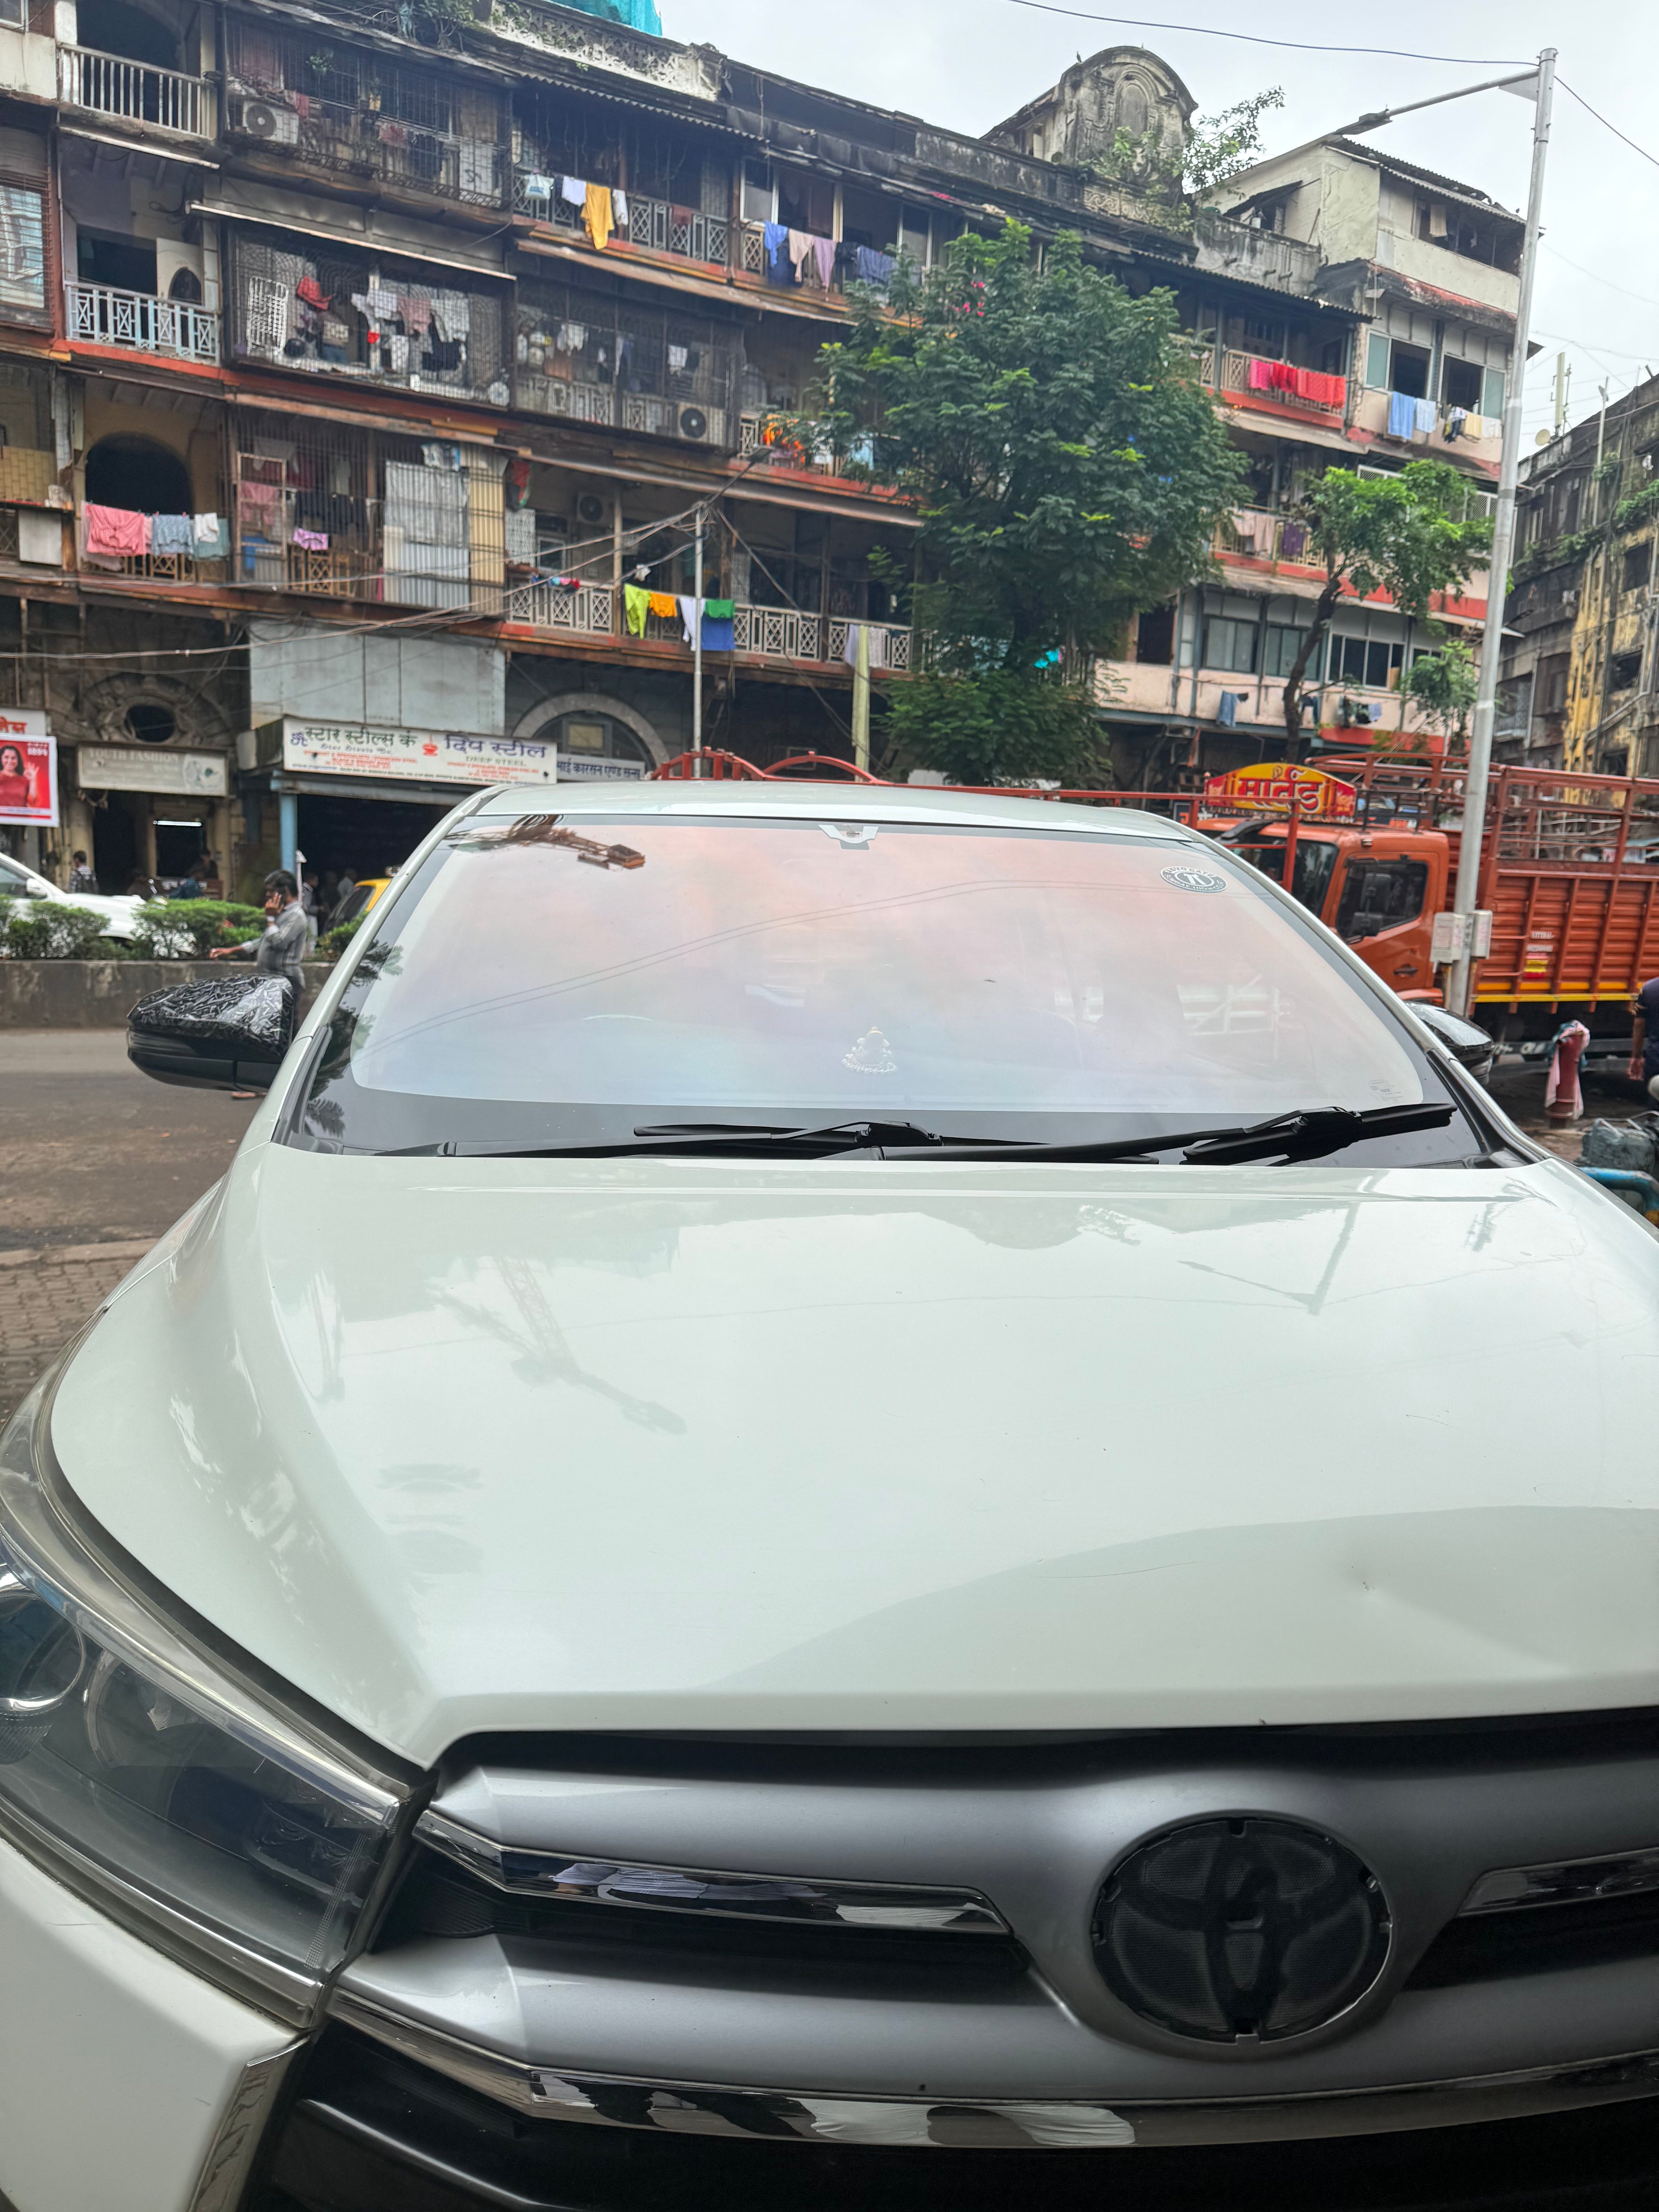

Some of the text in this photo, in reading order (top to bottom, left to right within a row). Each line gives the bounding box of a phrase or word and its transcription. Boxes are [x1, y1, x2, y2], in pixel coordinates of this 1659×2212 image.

[305, 726, 341, 743] स्टार
[344, 726, 394, 747] स्टील्स
[490, 739, 547, 758] स्टील
